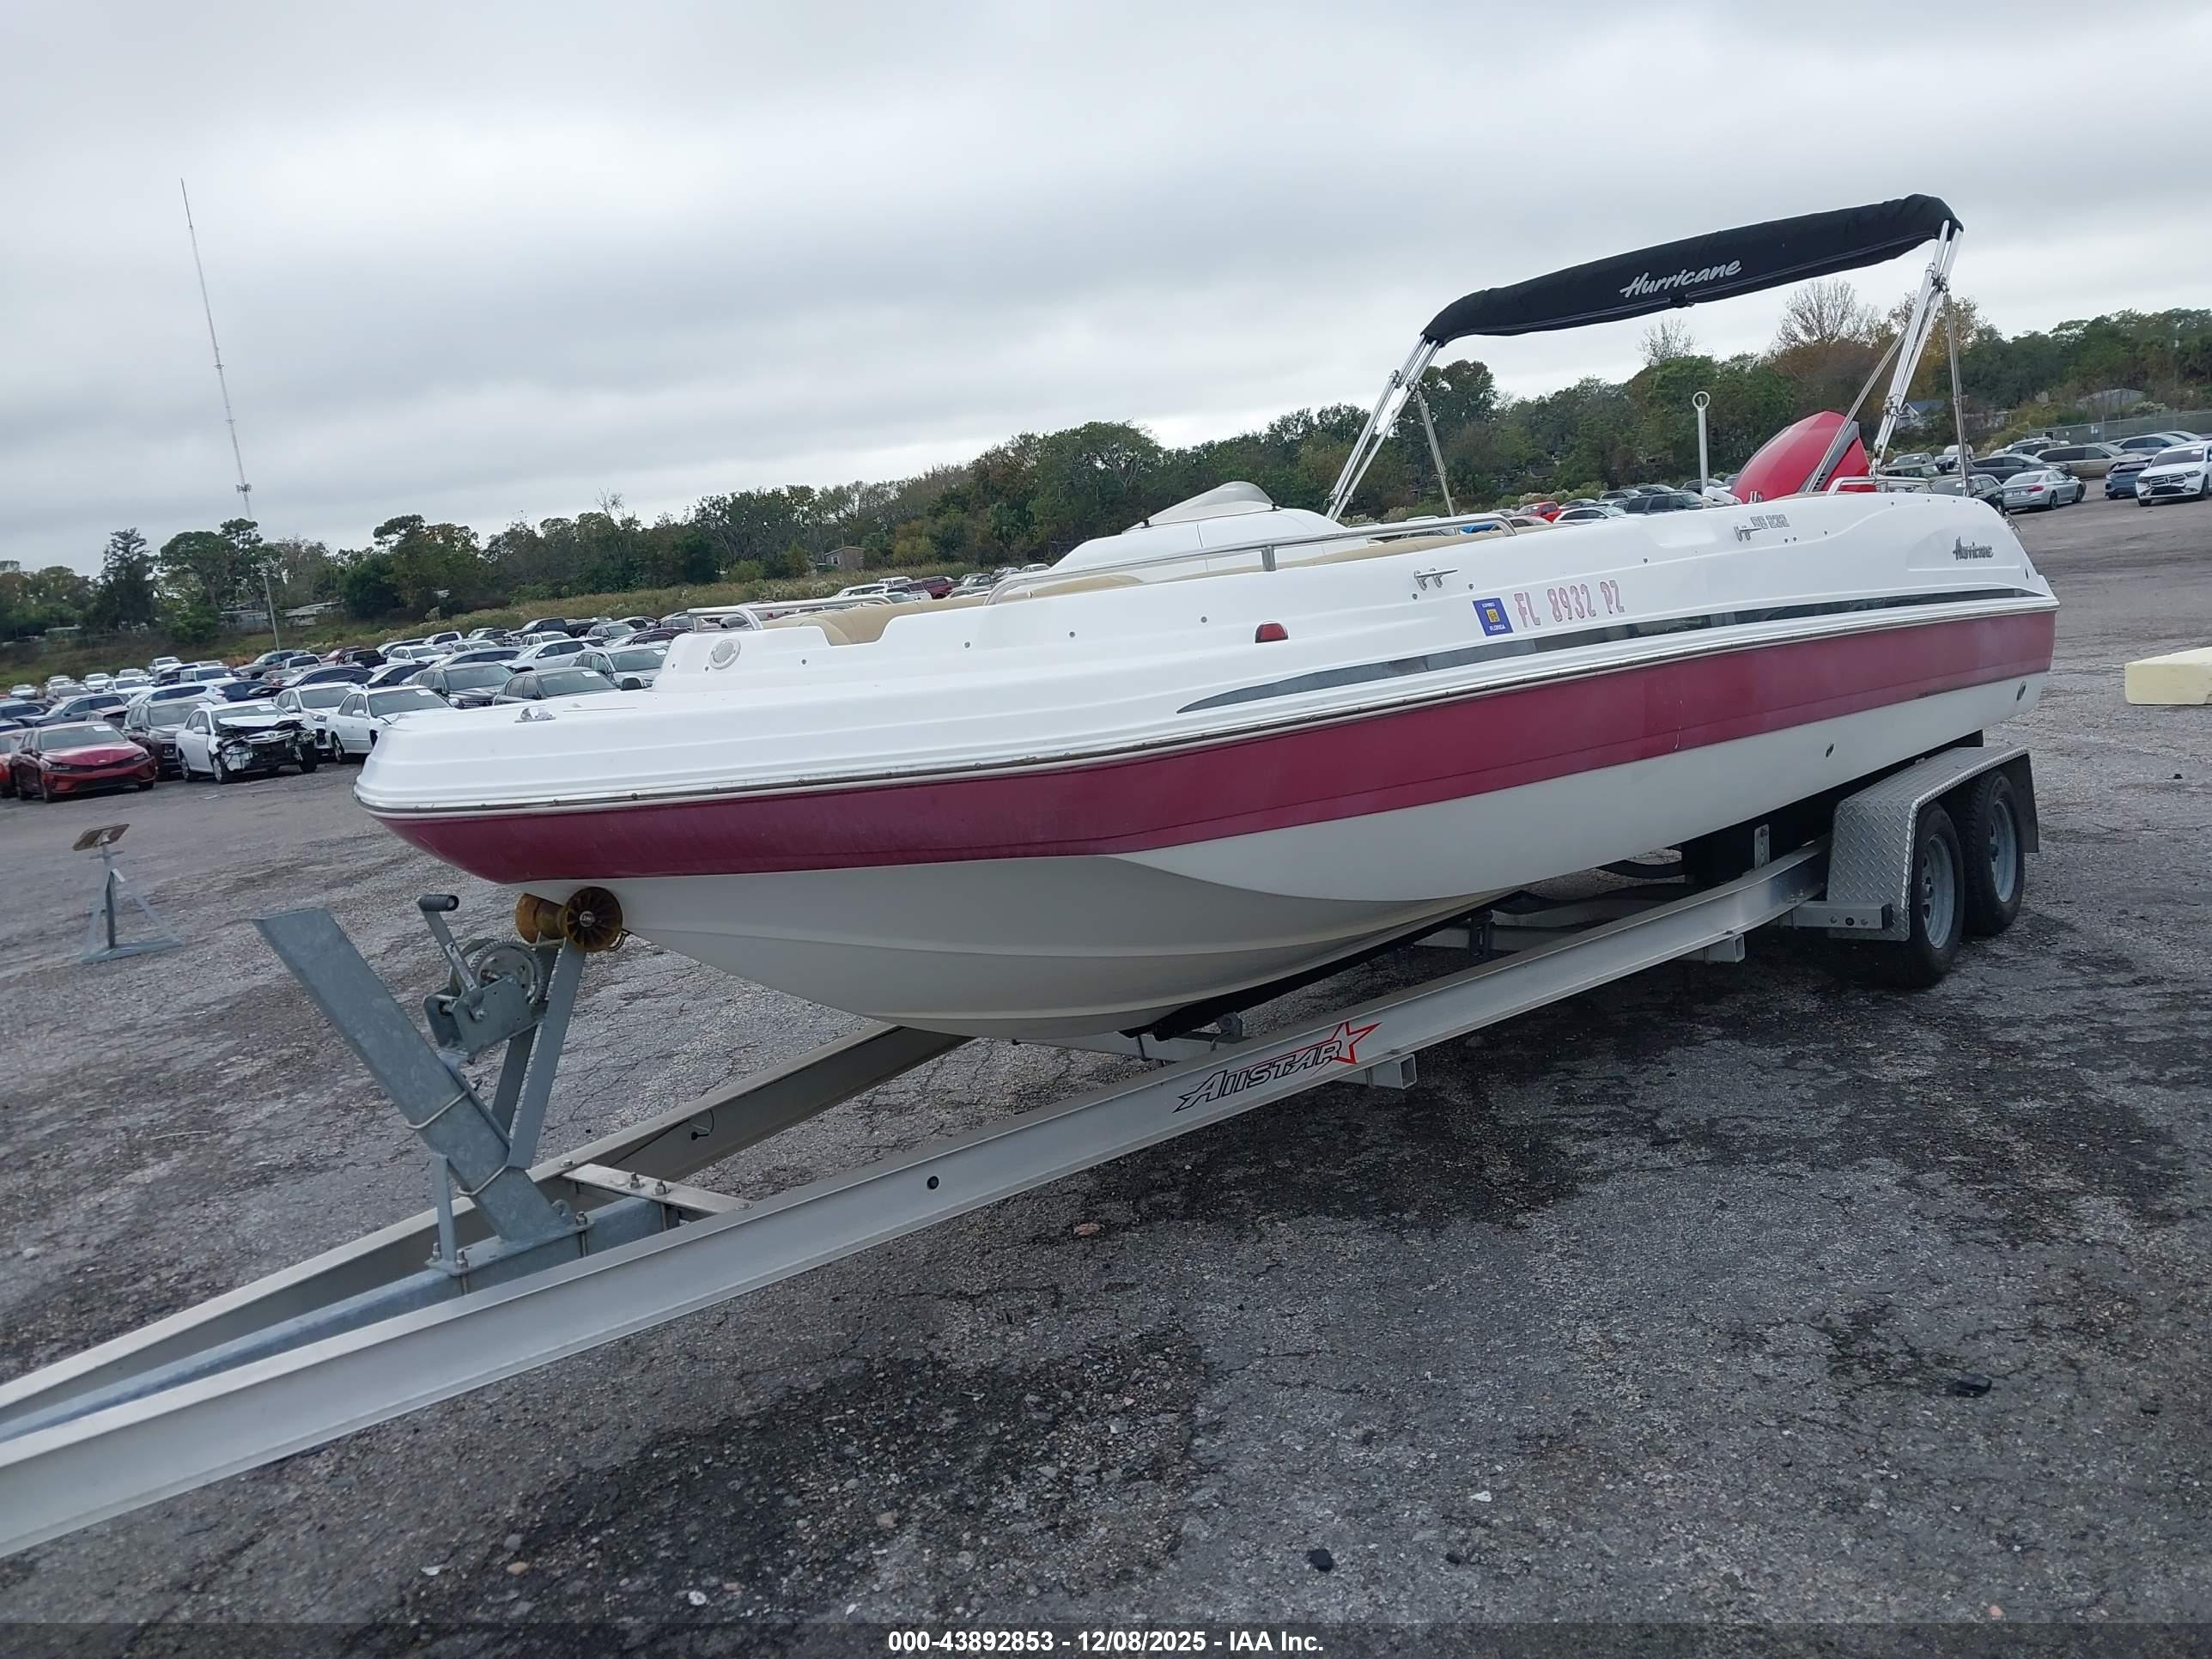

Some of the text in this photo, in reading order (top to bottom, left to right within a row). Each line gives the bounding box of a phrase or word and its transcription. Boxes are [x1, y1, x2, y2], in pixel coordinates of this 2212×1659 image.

[1620, 260, 1742, 299] Hurricane
[1952, 536, 1994, 561] Hurricane
[1514, 580, 1626, 628] FL 8932 PZ
